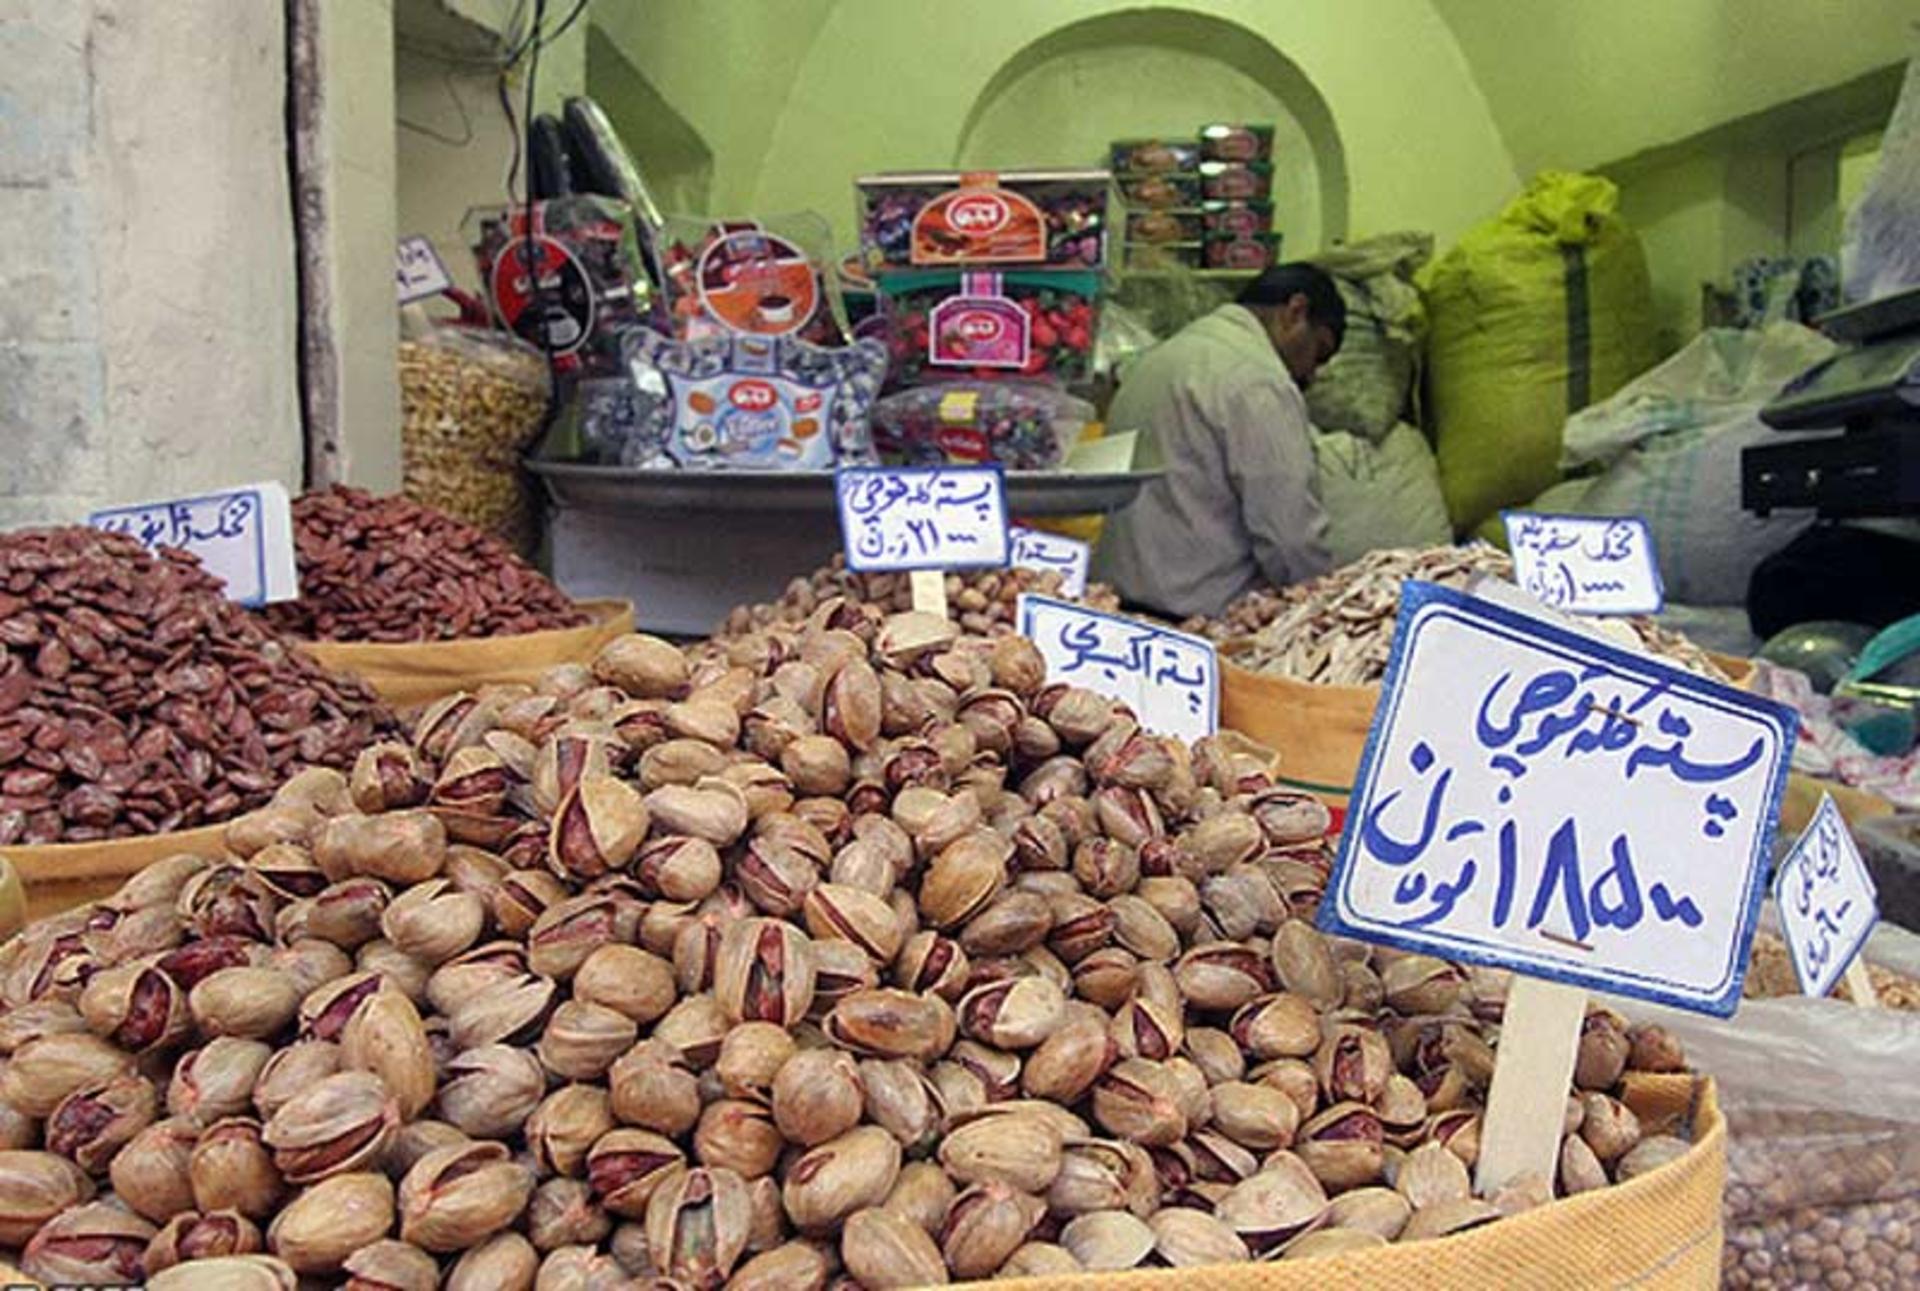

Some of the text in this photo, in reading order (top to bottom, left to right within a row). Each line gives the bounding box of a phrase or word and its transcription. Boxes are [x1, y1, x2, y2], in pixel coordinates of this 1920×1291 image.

[936, 480, 992, 521] پسته
[1061, 621, 1205, 714] پسته اکبری
[1477, 667, 1765, 838] پسته کله قوچی
